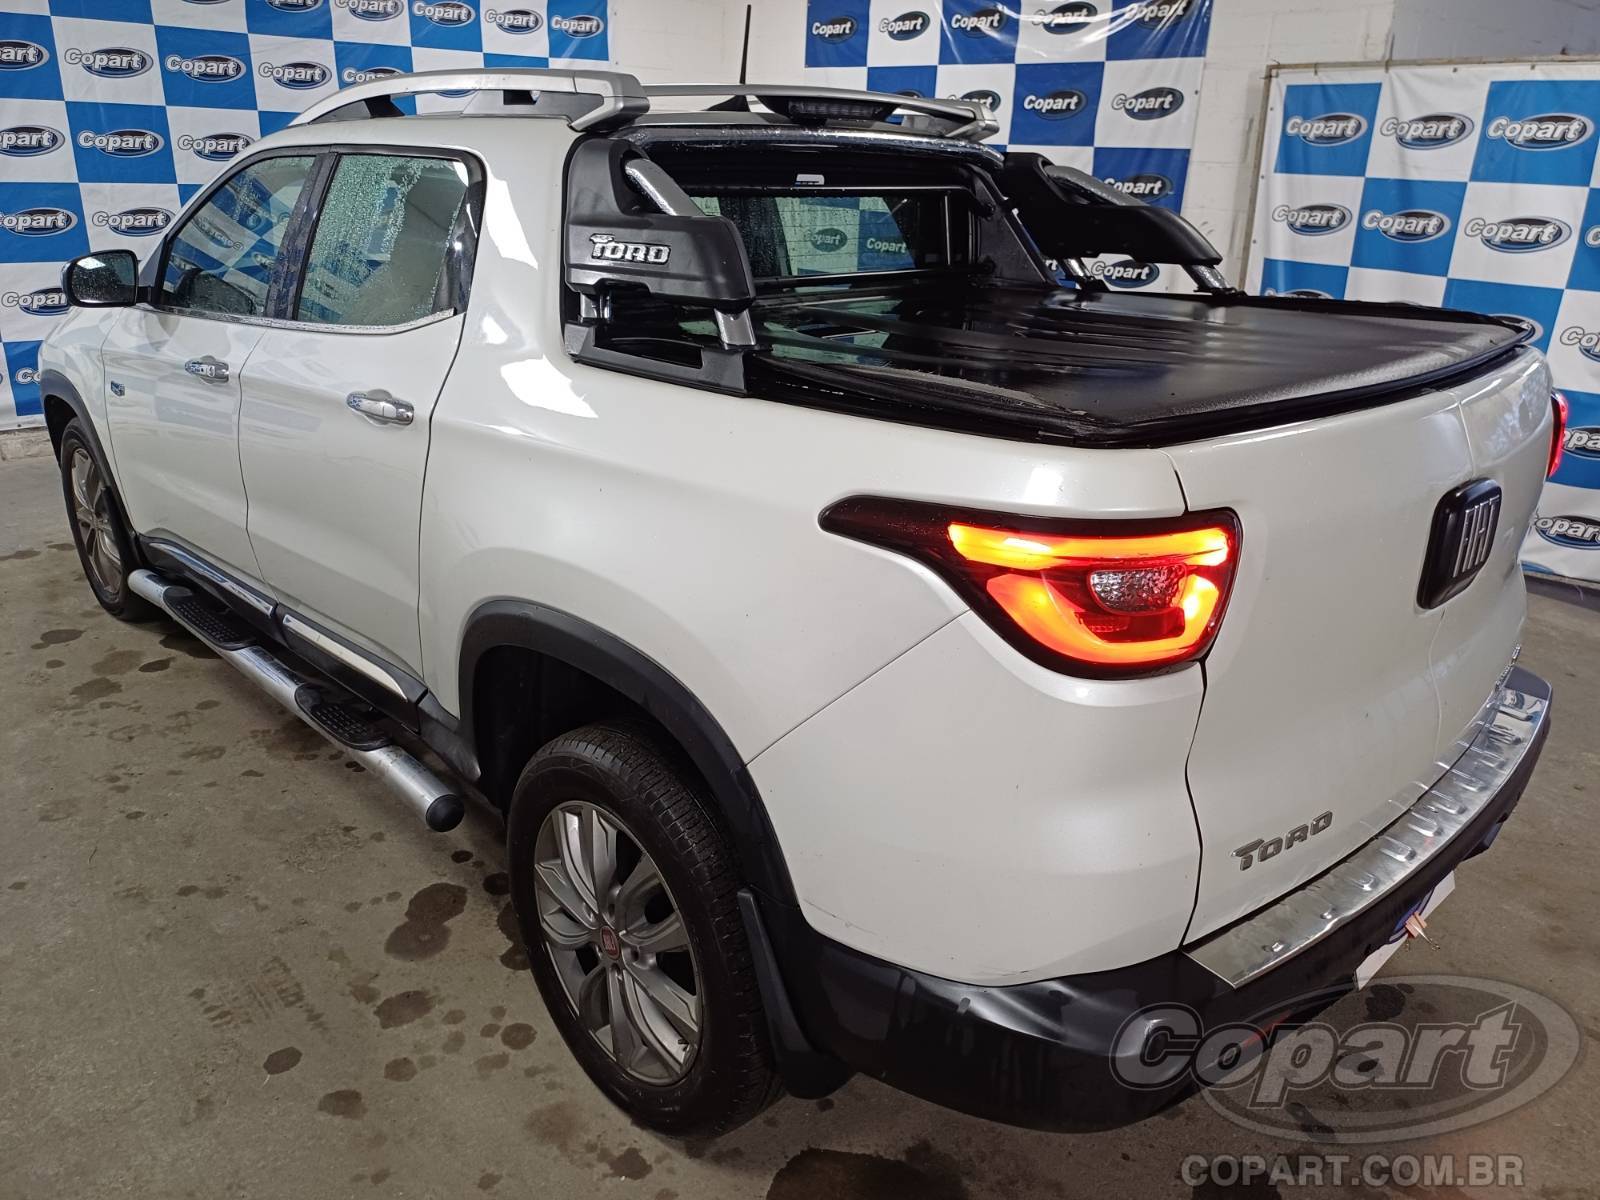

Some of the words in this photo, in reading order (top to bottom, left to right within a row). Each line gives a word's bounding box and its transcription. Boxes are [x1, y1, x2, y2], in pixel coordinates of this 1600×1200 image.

[413, 2, 468, 21] Copart
[485, 9, 536, 30] Copart
[952, 13, 1000, 29] Copart
[552, 16, 598, 33] Copart
[812, 21, 851, 37] Copart
[880, 15, 923, 33] Copart
[0, 46, 37, 63] art
[65, 48, 142, 70] Copart
[166, 55, 237, 76] Copart
[259, 62, 323, 82] Copart
[1024, 94, 1079, 114] Copart
[1112, 93, 1173, 112] Copart
[1286, 115, 1359, 137] Copart
[1380, 117, 1460, 139] Copart
[1487, 116, 1582, 143] Copart
[0, 130, 51, 149] part
[78, 130, 154, 150] Copart
[178, 135, 246, 154] Copart
[0, 212, 66, 231] opart
[92, 211, 165, 230] Copart
[1272, 204, 1343, 229] Copart
[1363, 210, 1440, 235] Copart
[1465, 217, 1558, 246] Copart
[590, 233, 670, 264] TORO
[867, 238, 907, 253] Copart
[1091, 261, 1150, 280] Copart
[1231, 810, 1333, 871] TORO
